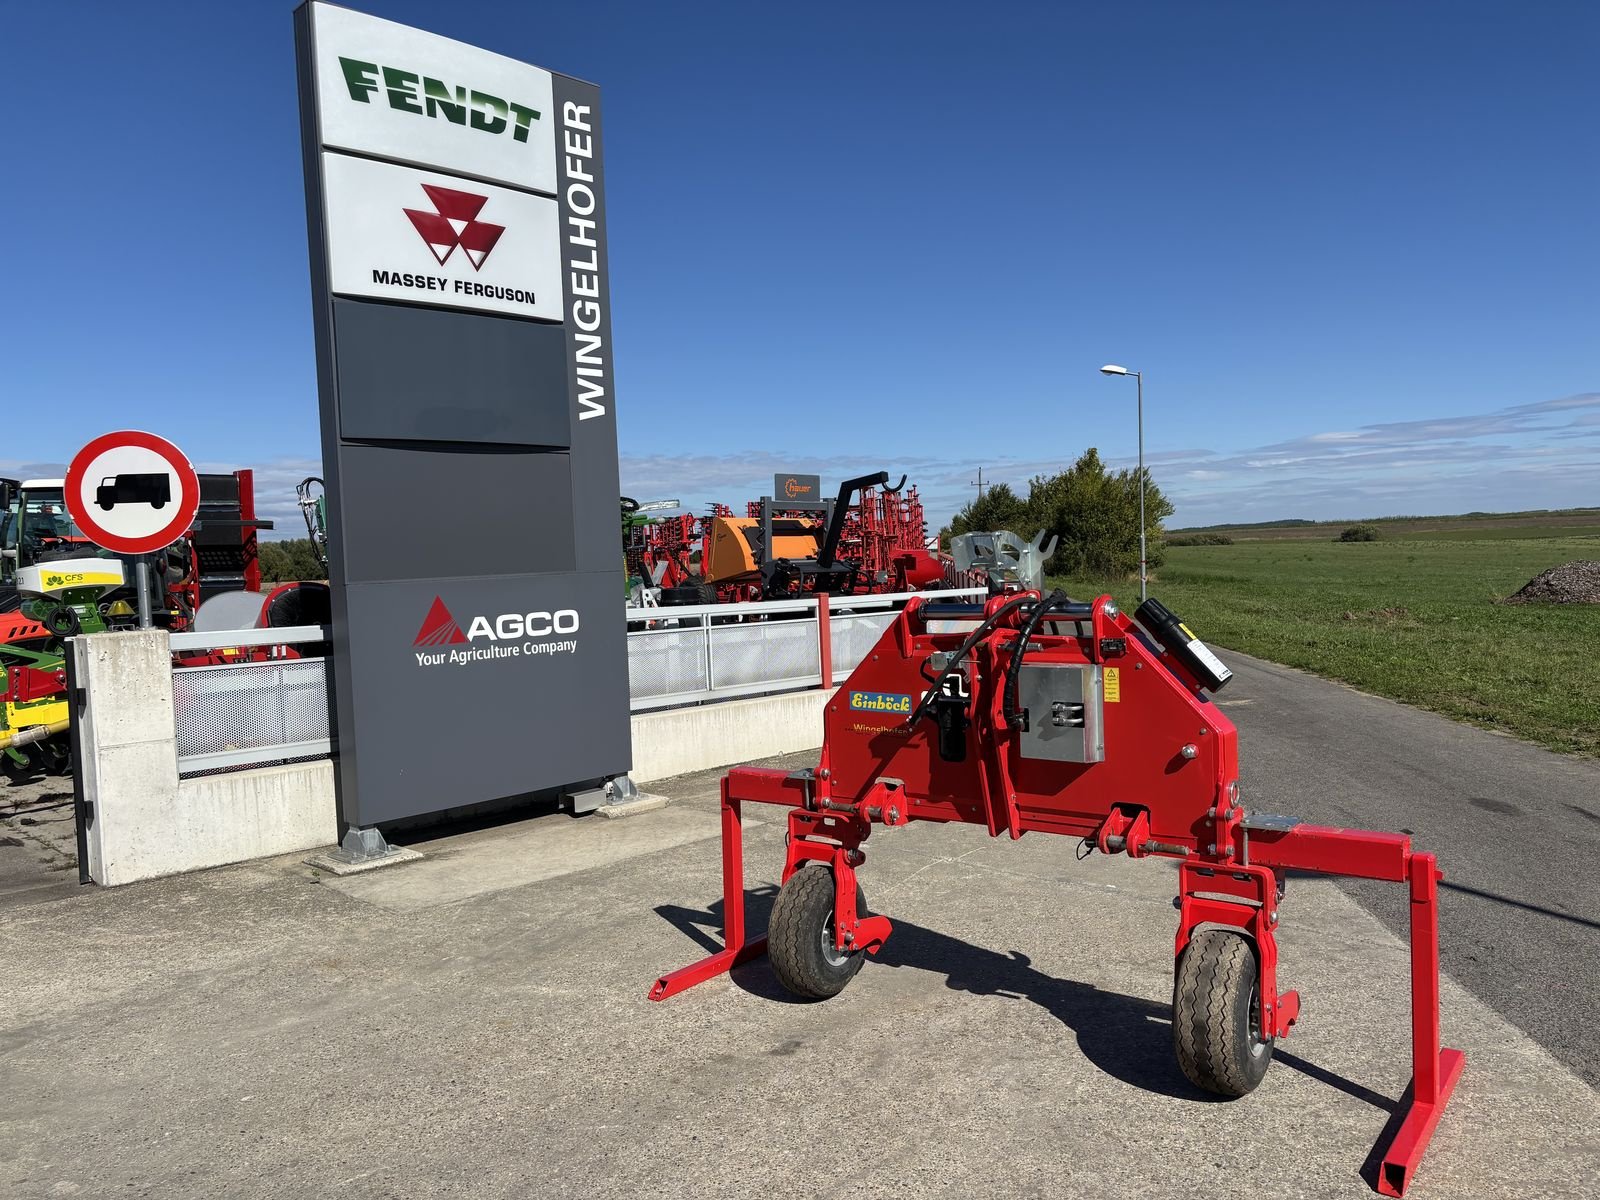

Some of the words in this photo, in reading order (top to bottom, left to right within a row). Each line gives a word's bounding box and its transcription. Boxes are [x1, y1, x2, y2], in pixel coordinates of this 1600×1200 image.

[338, 56, 541, 144] FENDT
[563, 101, 606, 421] WINGELHOFER
[372, 269, 448, 292] MASSEY
[454, 279, 536, 305] FERGUSON
[466, 609, 579, 642] AGCO
[416, 653, 445, 666] Your
[449, 644, 520, 666] Agriculture
[523, 640, 577, 655] Company
[851, 692, 910, 712] Einböck
